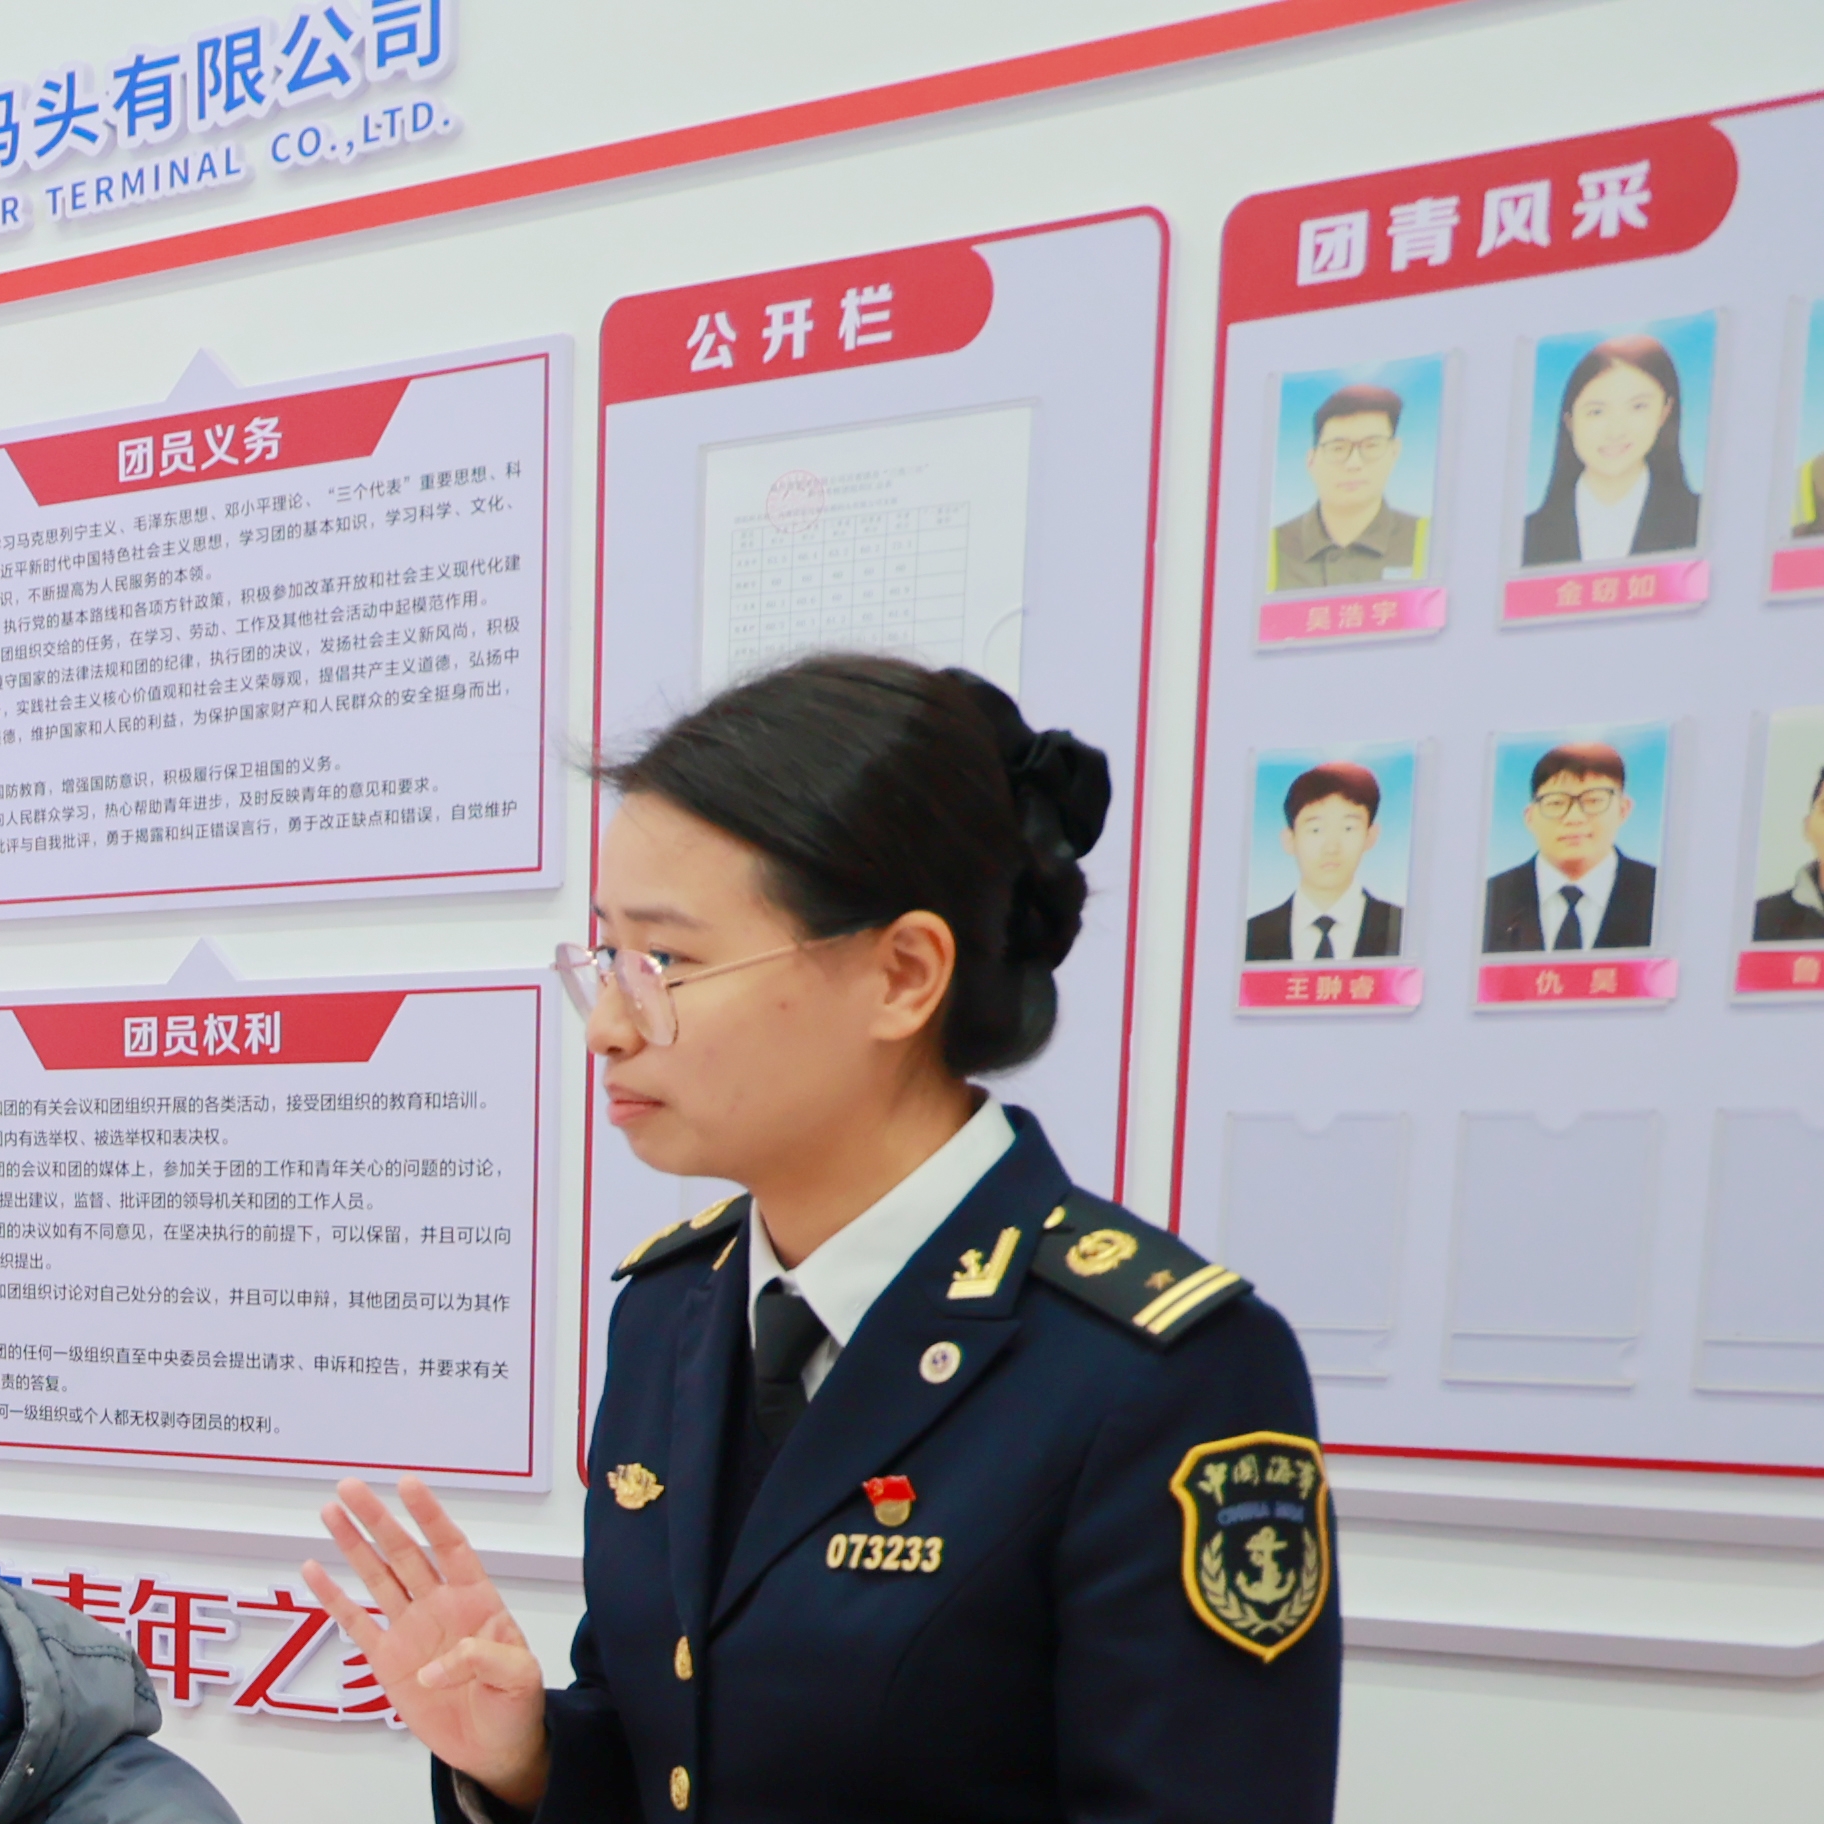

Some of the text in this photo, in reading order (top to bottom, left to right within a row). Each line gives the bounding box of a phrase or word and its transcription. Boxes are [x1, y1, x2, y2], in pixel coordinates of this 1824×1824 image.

[46, 147, 241, 216] TERMINAL
[271, 102, 450, 163] CO.,LTD.
[1296, 159, 1652, 287] 团青风采
[686, 283, 893, 373] 公开栏
[119, 416, 283, 482] 团员义务
[124, 1011, 282, 1057] 团员权利
[825, 1533, 943, 1574] 073233
